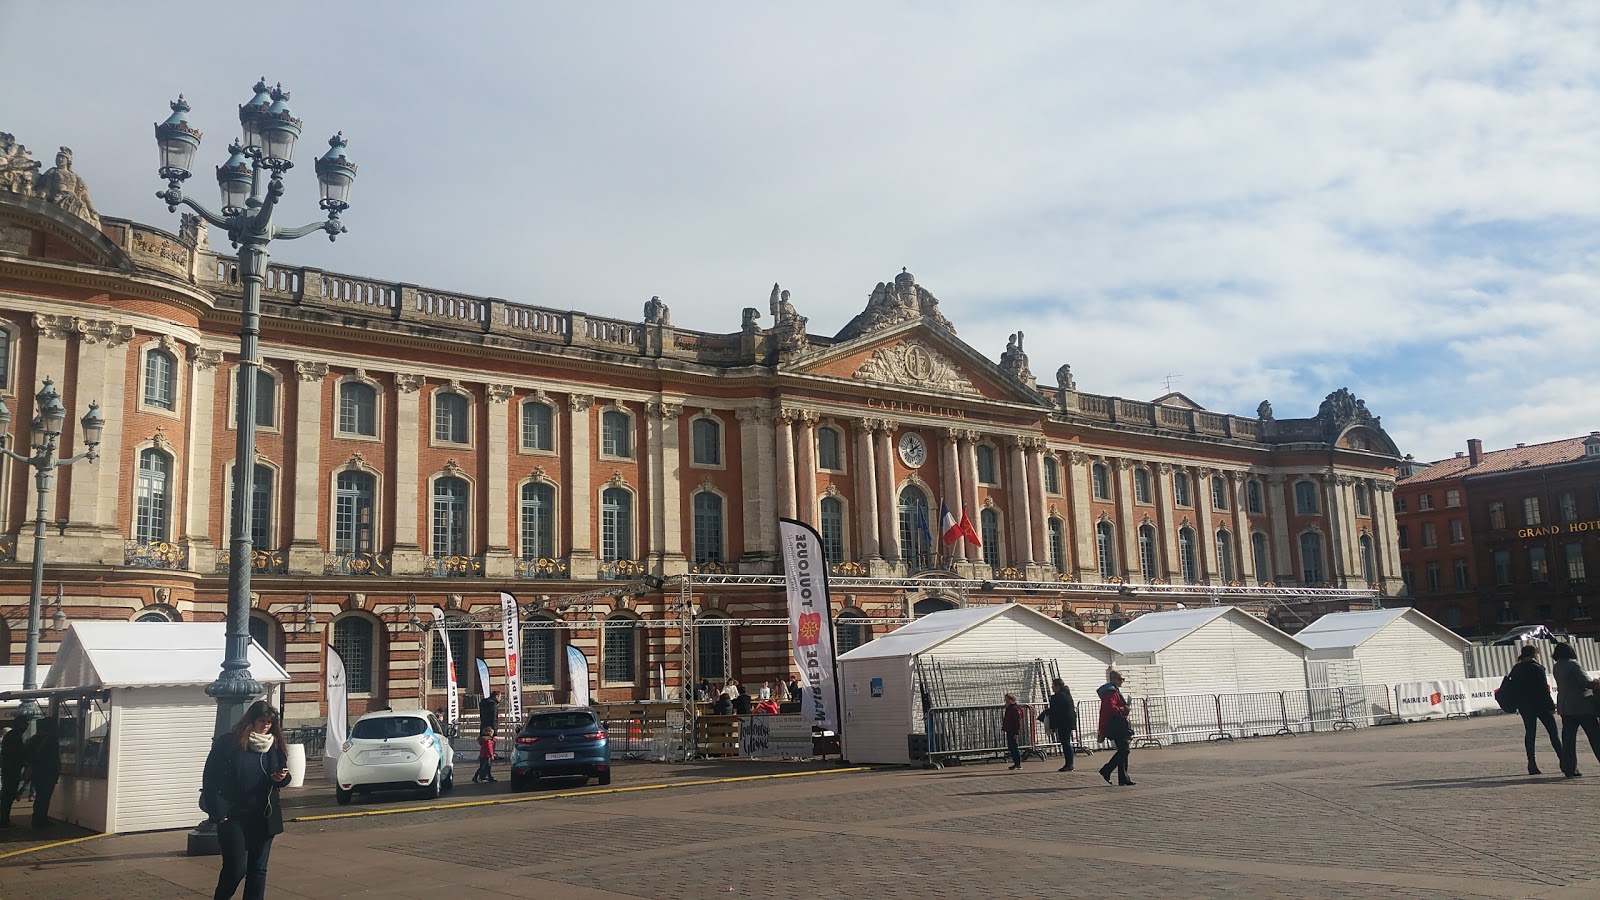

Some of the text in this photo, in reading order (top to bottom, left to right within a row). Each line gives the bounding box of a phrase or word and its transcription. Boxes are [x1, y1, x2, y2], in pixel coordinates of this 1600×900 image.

[867, 398, 965, 419] CAPITOLIUM
[1518, 525, 1560, 538] GRAND
[1402, 696, 1421, 704] MAIRIE
